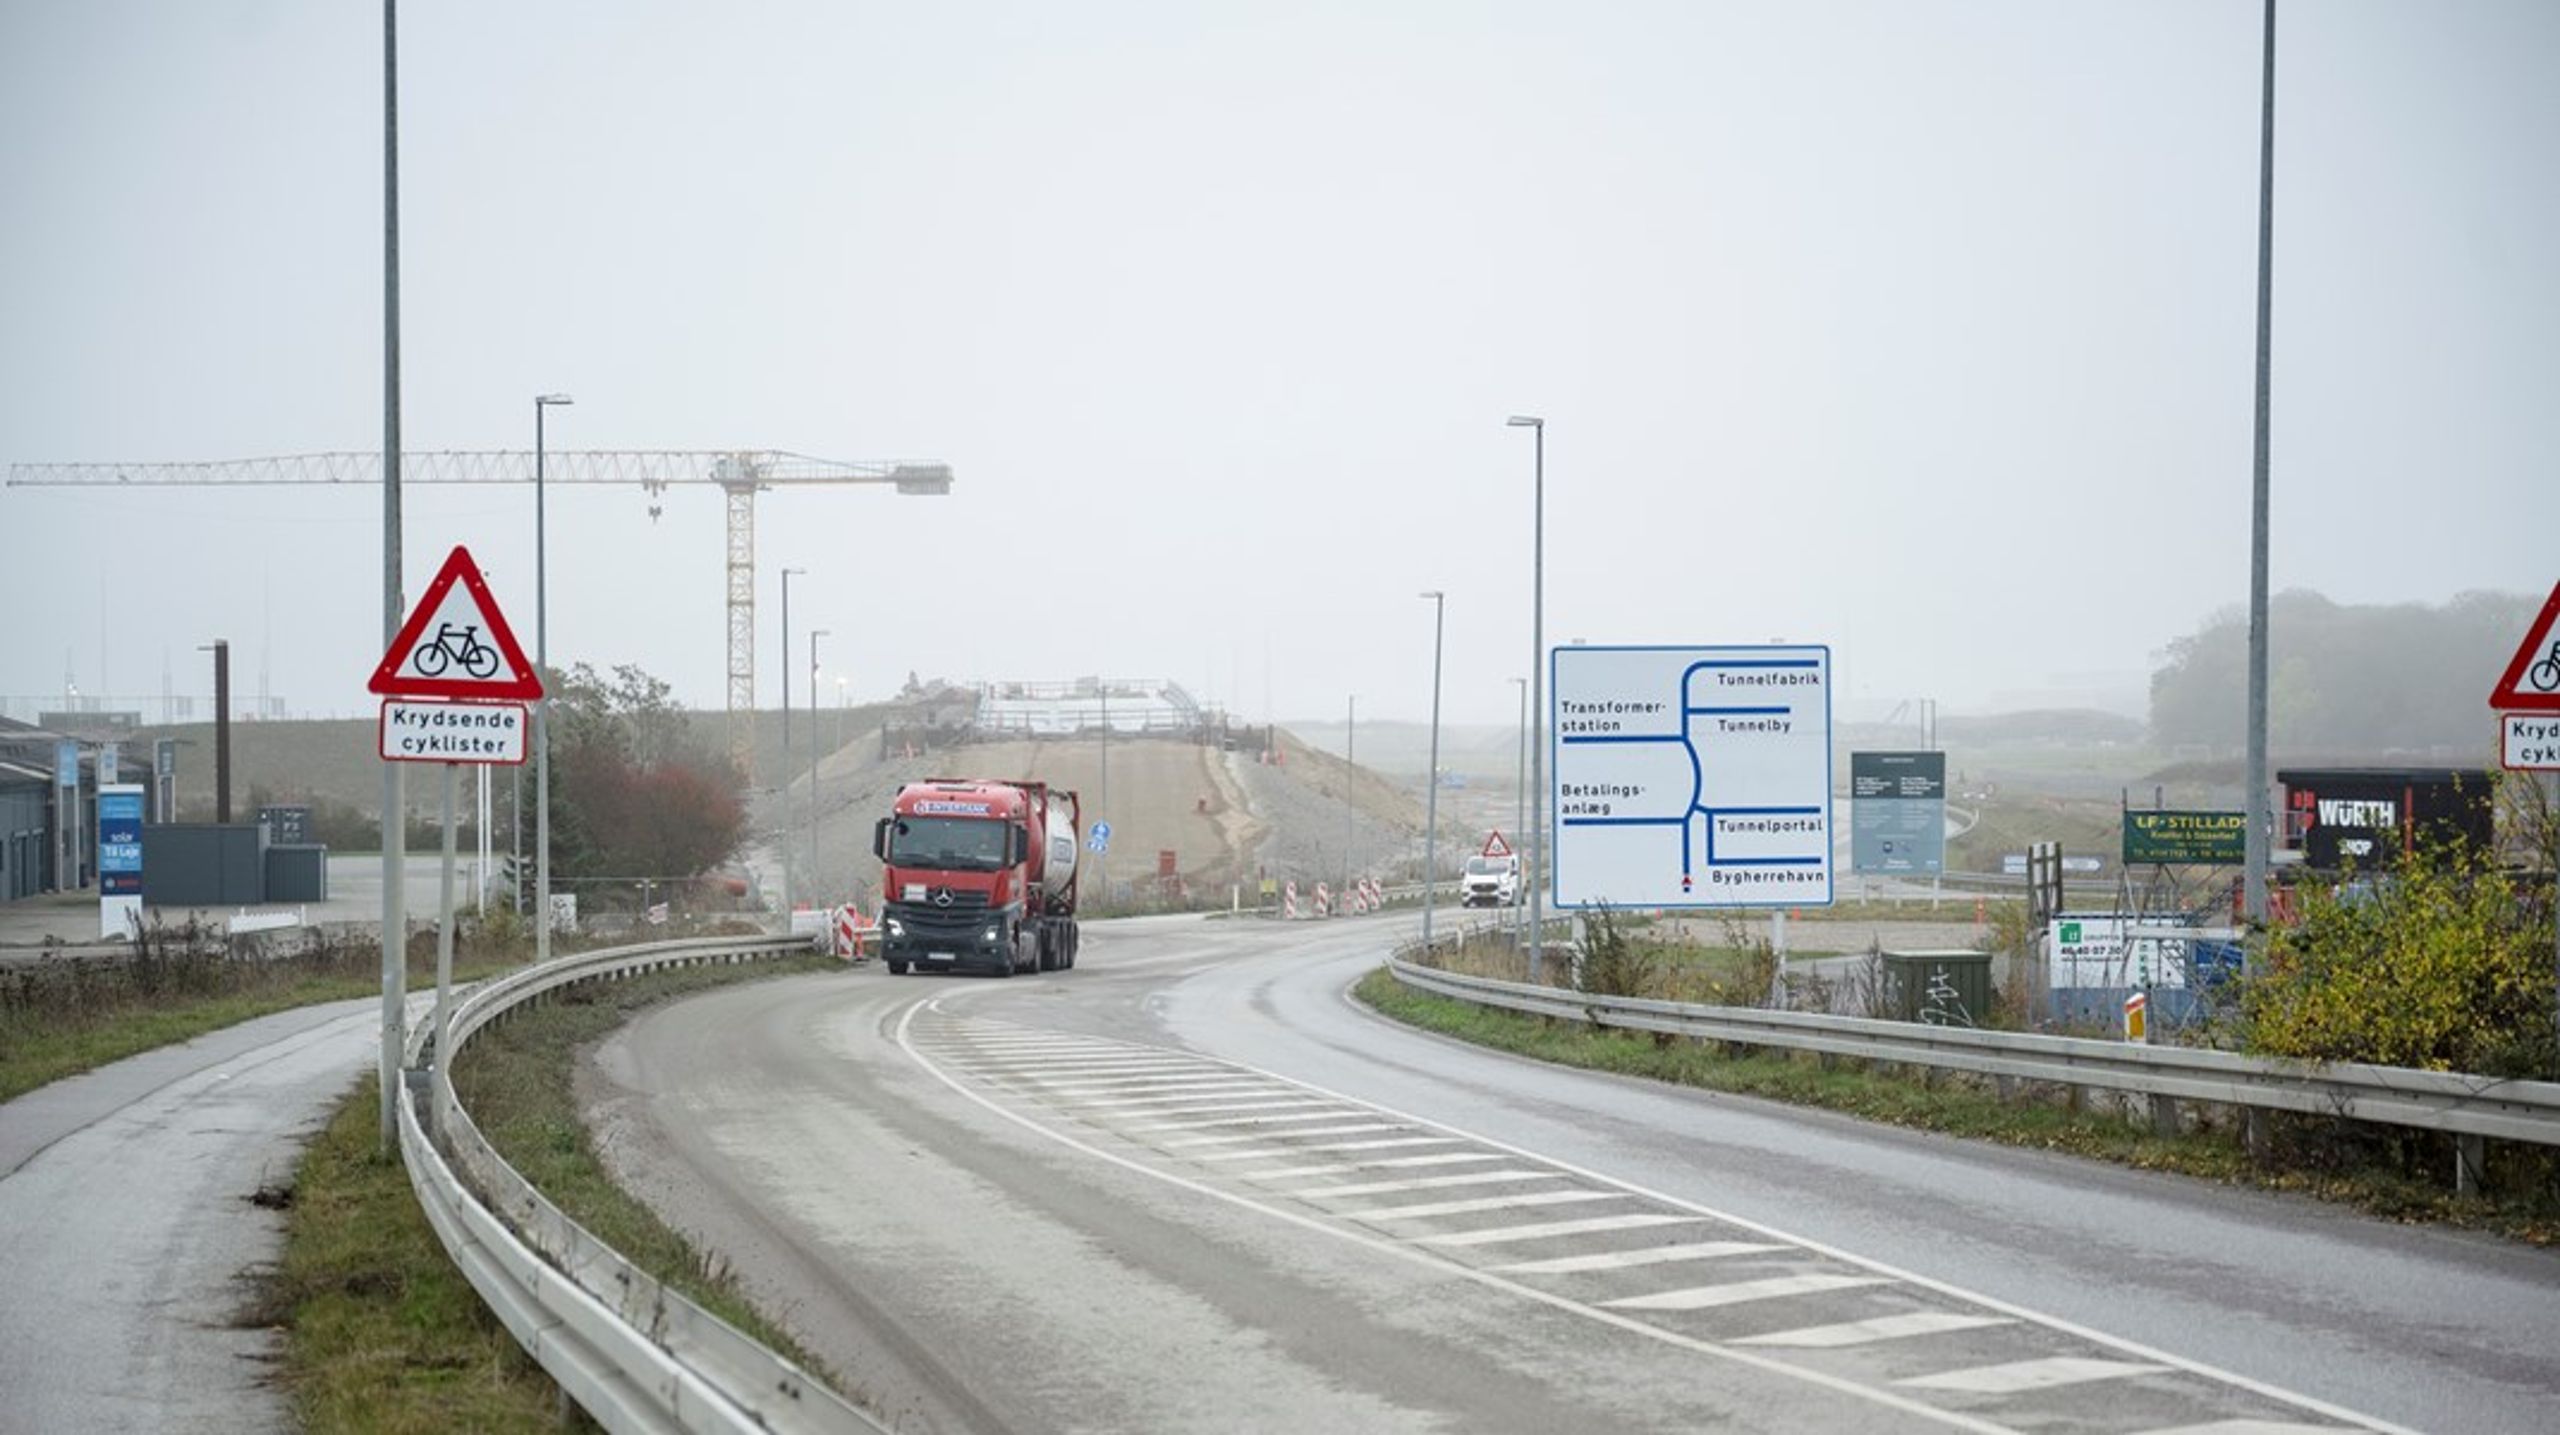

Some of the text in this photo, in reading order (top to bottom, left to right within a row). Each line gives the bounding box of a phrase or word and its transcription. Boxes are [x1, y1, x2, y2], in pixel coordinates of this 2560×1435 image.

[1718, 673, 1819, 686] Tunnelfabrik
[1562, 701, 1666, 714] Transformer-
[393, 709, 515, 729] Krydsende
[1718, 719, 1791, 733] Tunnelby
[1562, 720, 1621, 733] station
[402, 735, 506, 754] cyklister
[1562, 784, 1646, 798] Betalings-
[1562, 803, 1611, 816] anlæg
[2318, 799, 2396, 828] WÜRTH
[1718, 819, 1822, 833] Tunnelportal
[1712, 870, 1825, 885] Bygherrehavn
